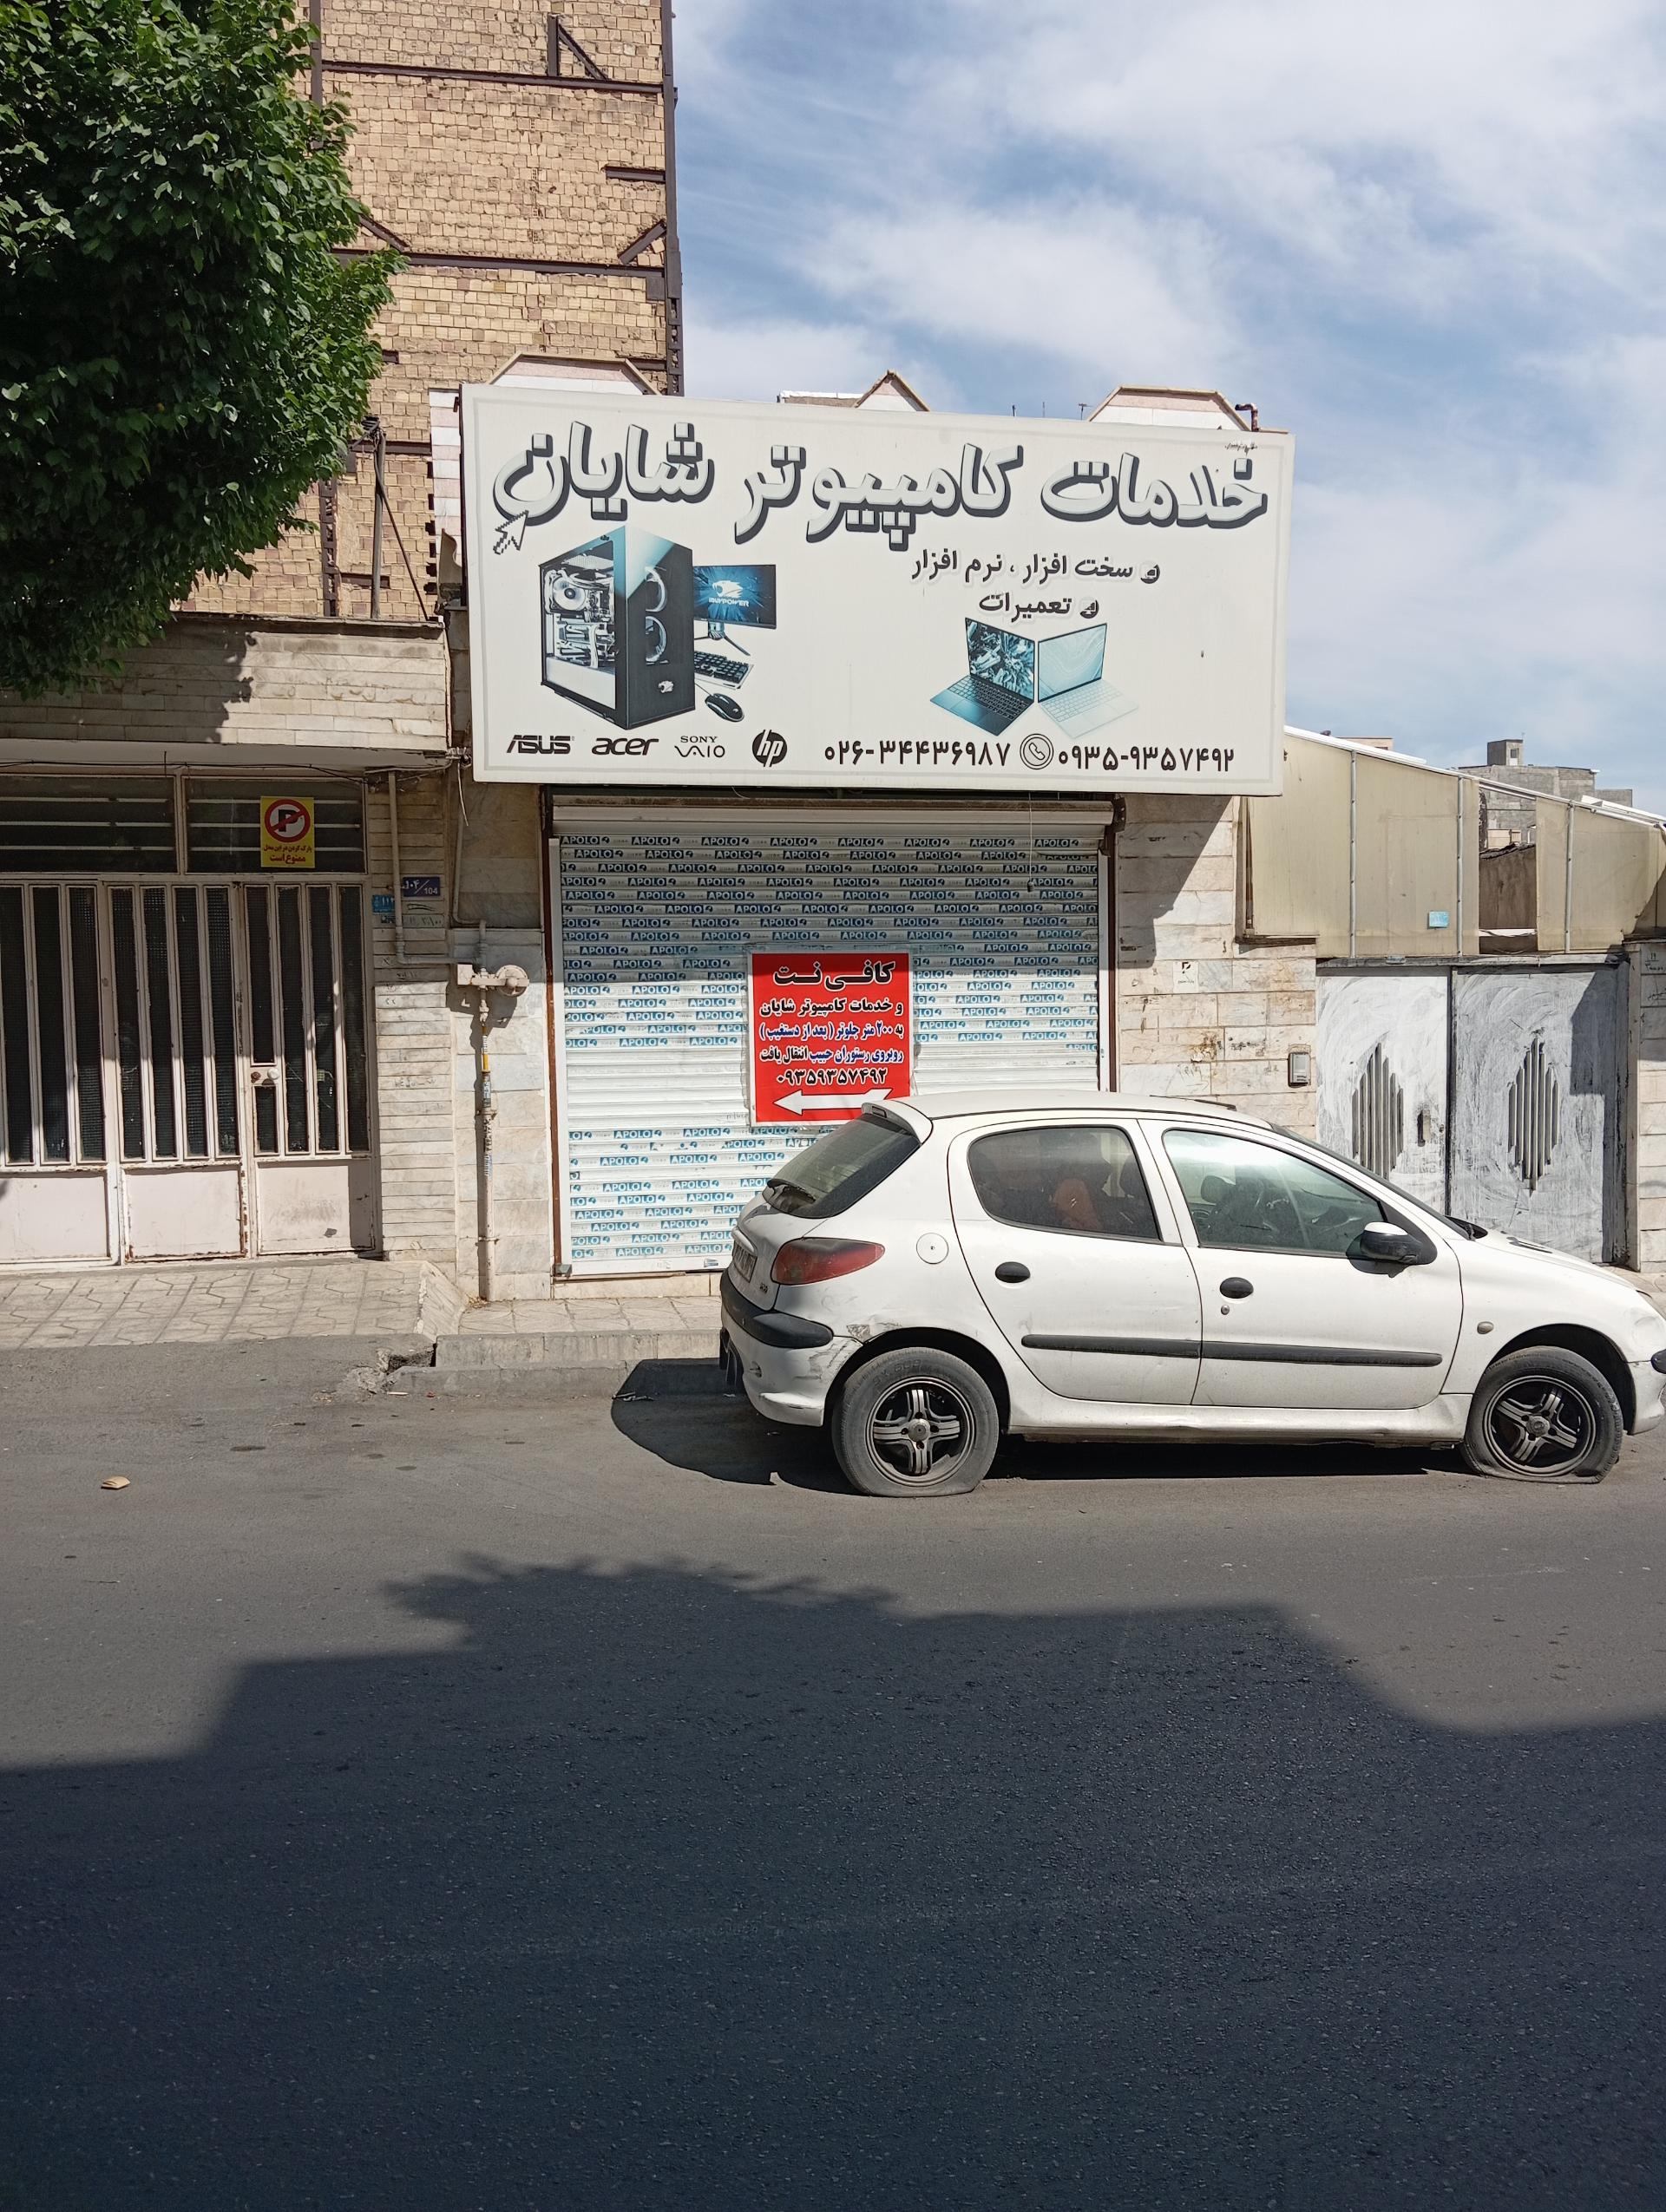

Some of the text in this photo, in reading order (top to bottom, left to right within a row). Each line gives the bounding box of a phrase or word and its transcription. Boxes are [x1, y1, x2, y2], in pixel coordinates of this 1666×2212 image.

[493, 422, 715, 526] شایان
[735, 443, 1024, 551] کامپیوتر
[912, 548, 957, 579] افزار
[966, 554, 1002, 582] نرم
[1023, 553, 1066, 584] افزار
[1075, 557, 1132, 578] سخت
[979, 592, 1072, 622] تعمیرات
[507, 734, 659, 756] ASUS acer
[674, 745, 725, 758] VAIO
[753, 730, 787, 767] hp
[771, 837, 808, 846] APOLO
[715, 850, 752, 859] APOLO
[850, 851, 886, 860] APOLO
[669, 864, 706, 873] APOLO
[738, 864, 774, 873] APOLO
[806, 864, 842, 873] APOLO
[767, 878, 803, 887] APOLO
[834, 878, 869, 887] APOLO
[567, 891, 605, 900] APOLO
[638, 891, 674, 900] APOLO
[595, 905, 633, 913] APOLO
[666, 905, 703, 913] APOLO
[735, 905, 771, 913] APOLO
[803, 905, 838, 913] APOLO
[623, 919, 660, 927] APOLO
[692, 919, 729, 927] APOLO
[632, 933, 669, 941] APOLO
[772, 932, 810, 940] APOLO
[908, 931, 943, 939] APOLO
[1038, 930, 1072, 939] APOLO
[580, 946, 619, 955] APOLO
[614, 959, 652, 969] APOLO
[683, 959, 720, 968] APOLO
[639, 972, 676, 981] APOLO
[773, 960, 895, 991] کافی نت
[688, 998, 725, 1007] APOLO
[760, 998, 902, 1017] و خدمات کامپیوتر شایان
[696, 1011, 733, 1020] APOLO
[802, 1023, 811, 1040] از
[836, 1023, 859, 1040] جلوتر
[862, 1024, 875, 1039] متر
[876, 1021, 893, 1035] ۲۰۰
[895, 1026, 903, 1039] به
[760, 1047, 903, 1064] روبروی رستوران حبیب انتقال یافت
[777, 1068, 888, 1085] ۰۹۳۵۹۳۵۷۴۹۲
[600, 1156, 639, 1165] APOLO
[619, 1195, 656, 1204] APOLO
[575, 1210, 613, 1219] APOLO
